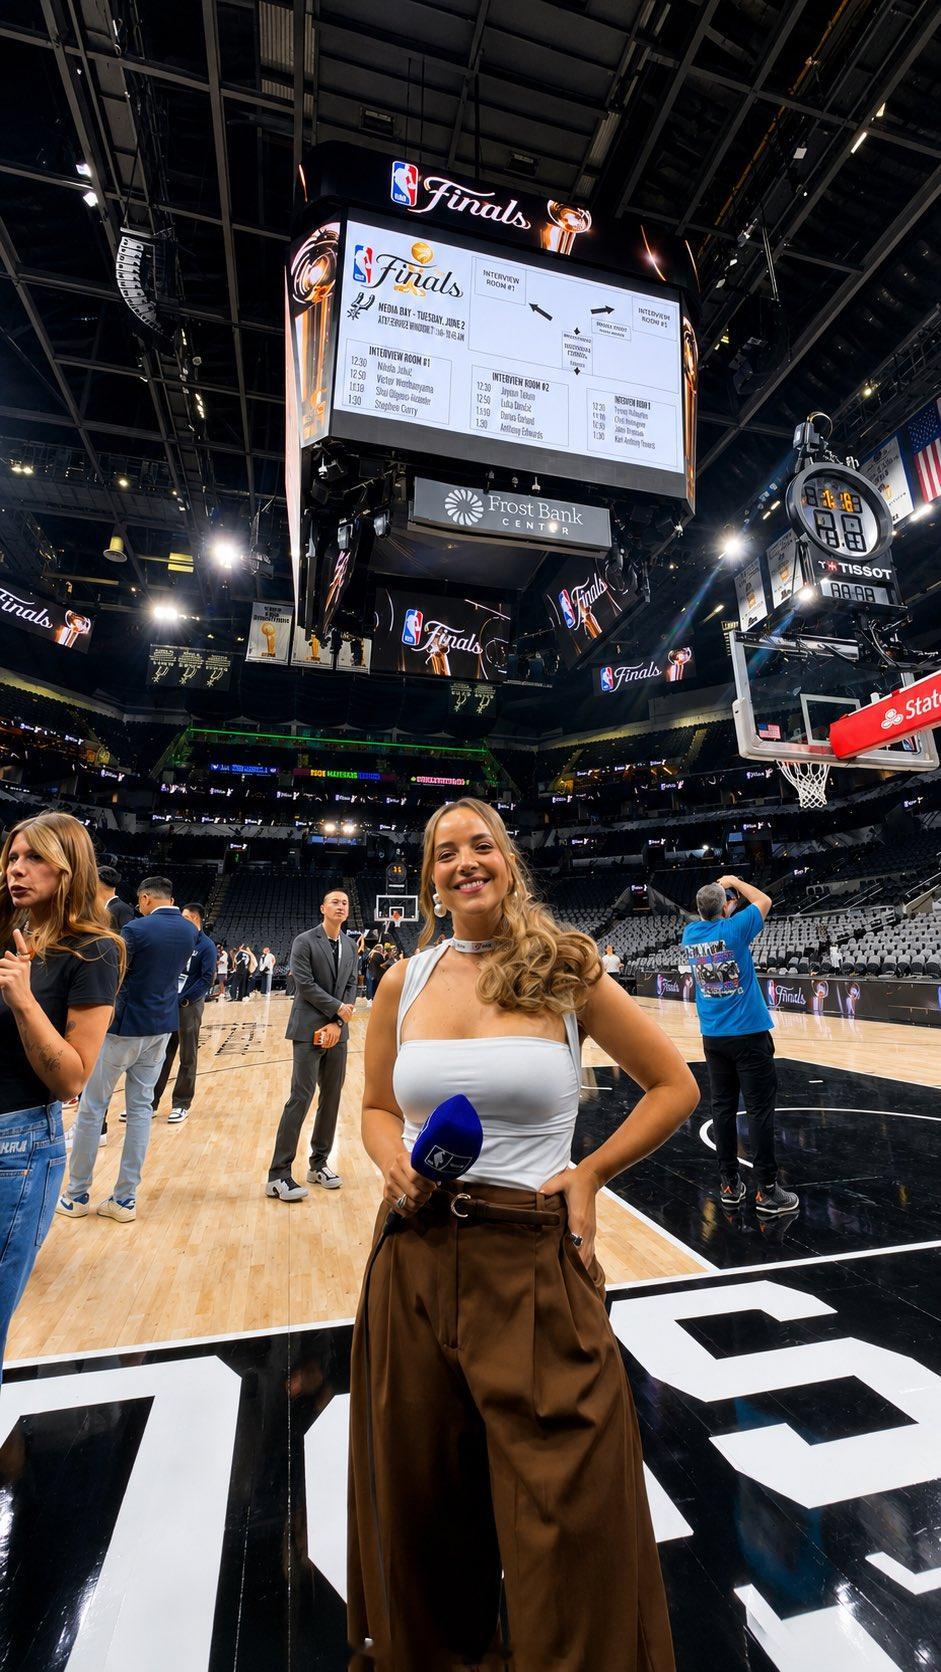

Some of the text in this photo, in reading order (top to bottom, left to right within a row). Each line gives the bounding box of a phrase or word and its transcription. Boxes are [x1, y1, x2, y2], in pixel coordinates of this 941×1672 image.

[407, 176, 532, 230] Finals
[361, 253, 463, 298] Finals
[482, 269, 520, 285] INTERVIEW
[486, 278, 507, 290] ROOM
[488, 494, 584, 526] Frost Bank
[838, 561, 892, 580] TISSOT
[573, 572, 608, 631] Finals
[411, 620, 483, 655] Finals
[609, 661, 662, 692] Finals
[905, 689, 941, 720] Stat
